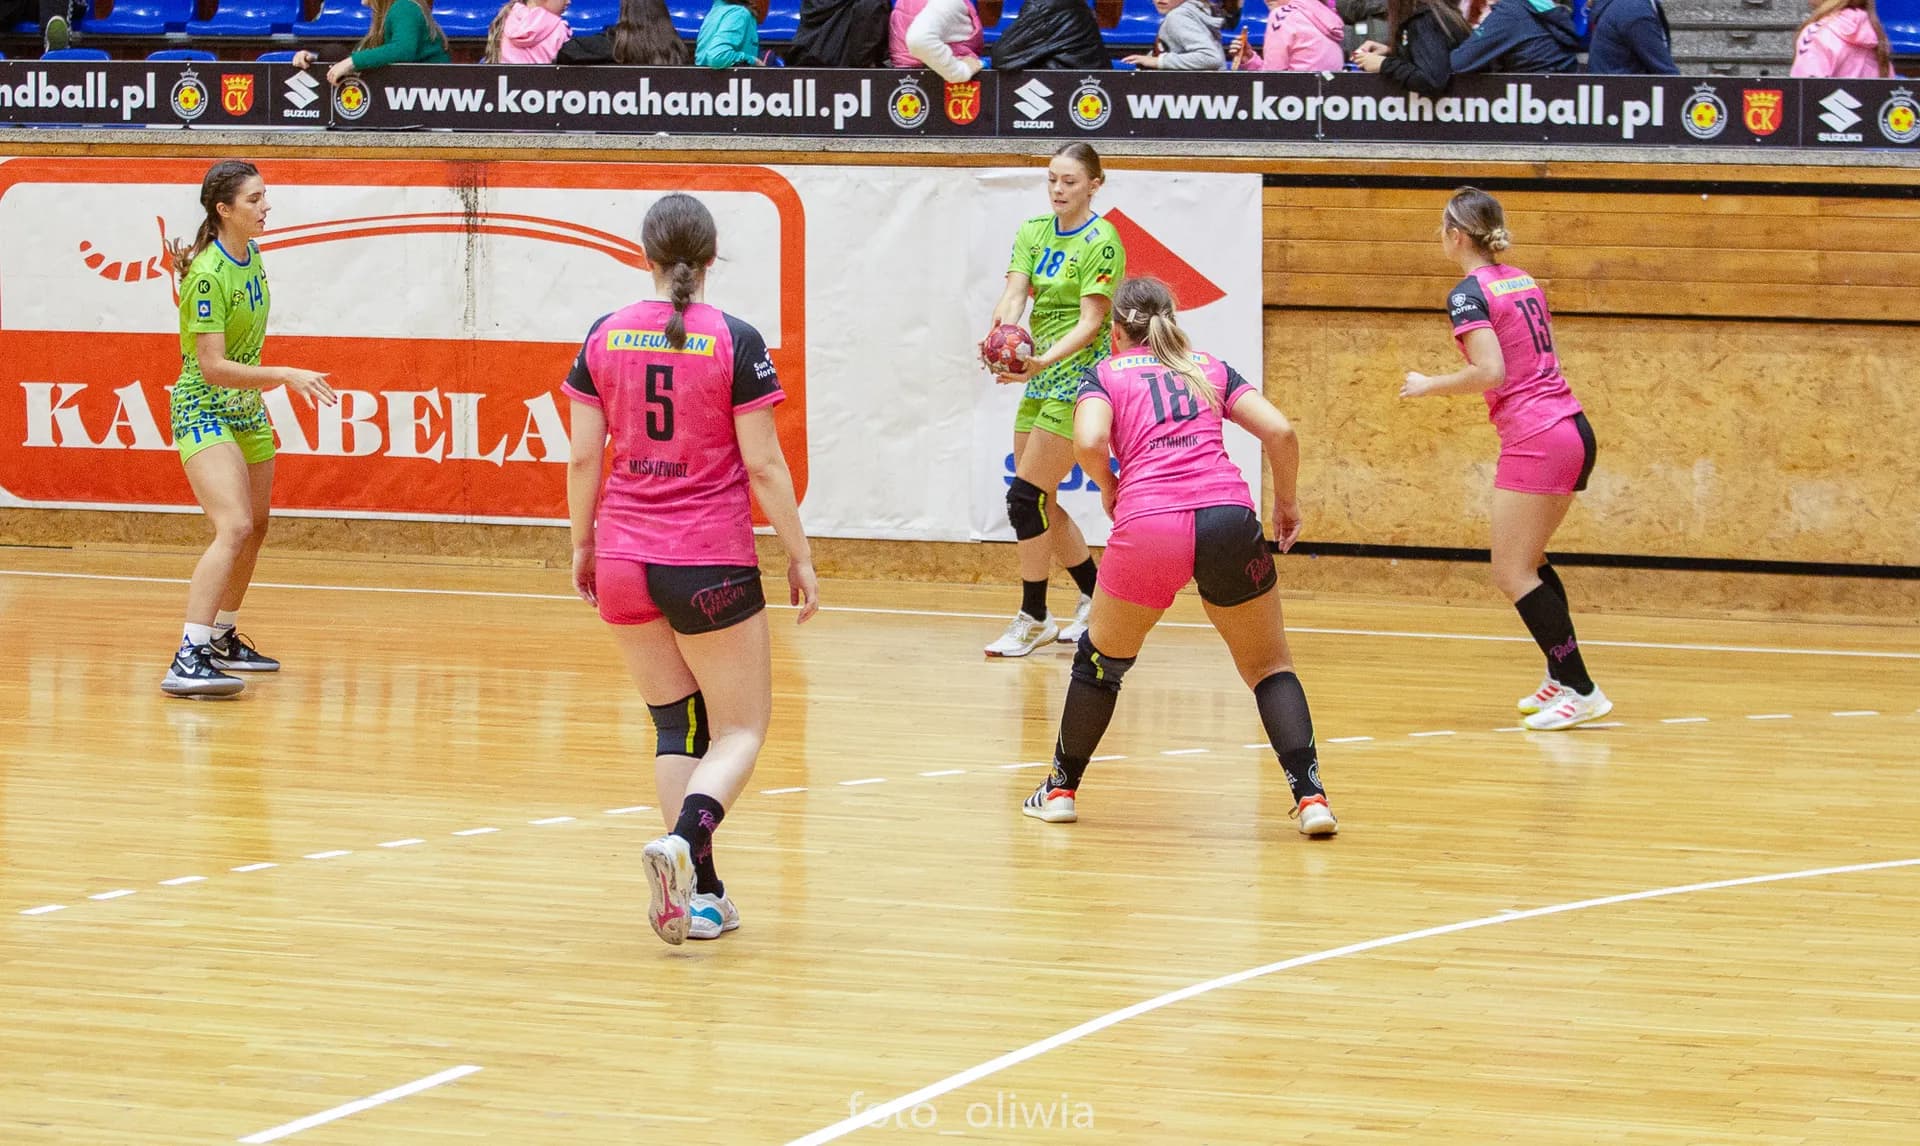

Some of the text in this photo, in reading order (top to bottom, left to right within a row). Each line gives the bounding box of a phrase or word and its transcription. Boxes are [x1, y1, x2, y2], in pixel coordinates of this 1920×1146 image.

[225, 90, 248, 111] CK
[283, 109, 320, 118] SUZUKI
[384, 76, 871, 130] www.koronahandball.pl
[948, 98, 973, 120] CK
[1126, 81, 1664, 139] www.koronahandball.pl
[1013, 119, 1054, 129] SUZUKI
[1746, 107, 1774, 130] CK
[1035, 247, 1065, 278] 18
[246, 275, 264, 312] 14
[1515, 298, 1553, 354] 13
[633, 334, 708, 351] LEWIAN
[645, 364, 674, 441] 5
[1140, 370, 1199, 425] 18
[20, 381, 574, 467] KAABELA
[190, 419, 222, 443] 14
